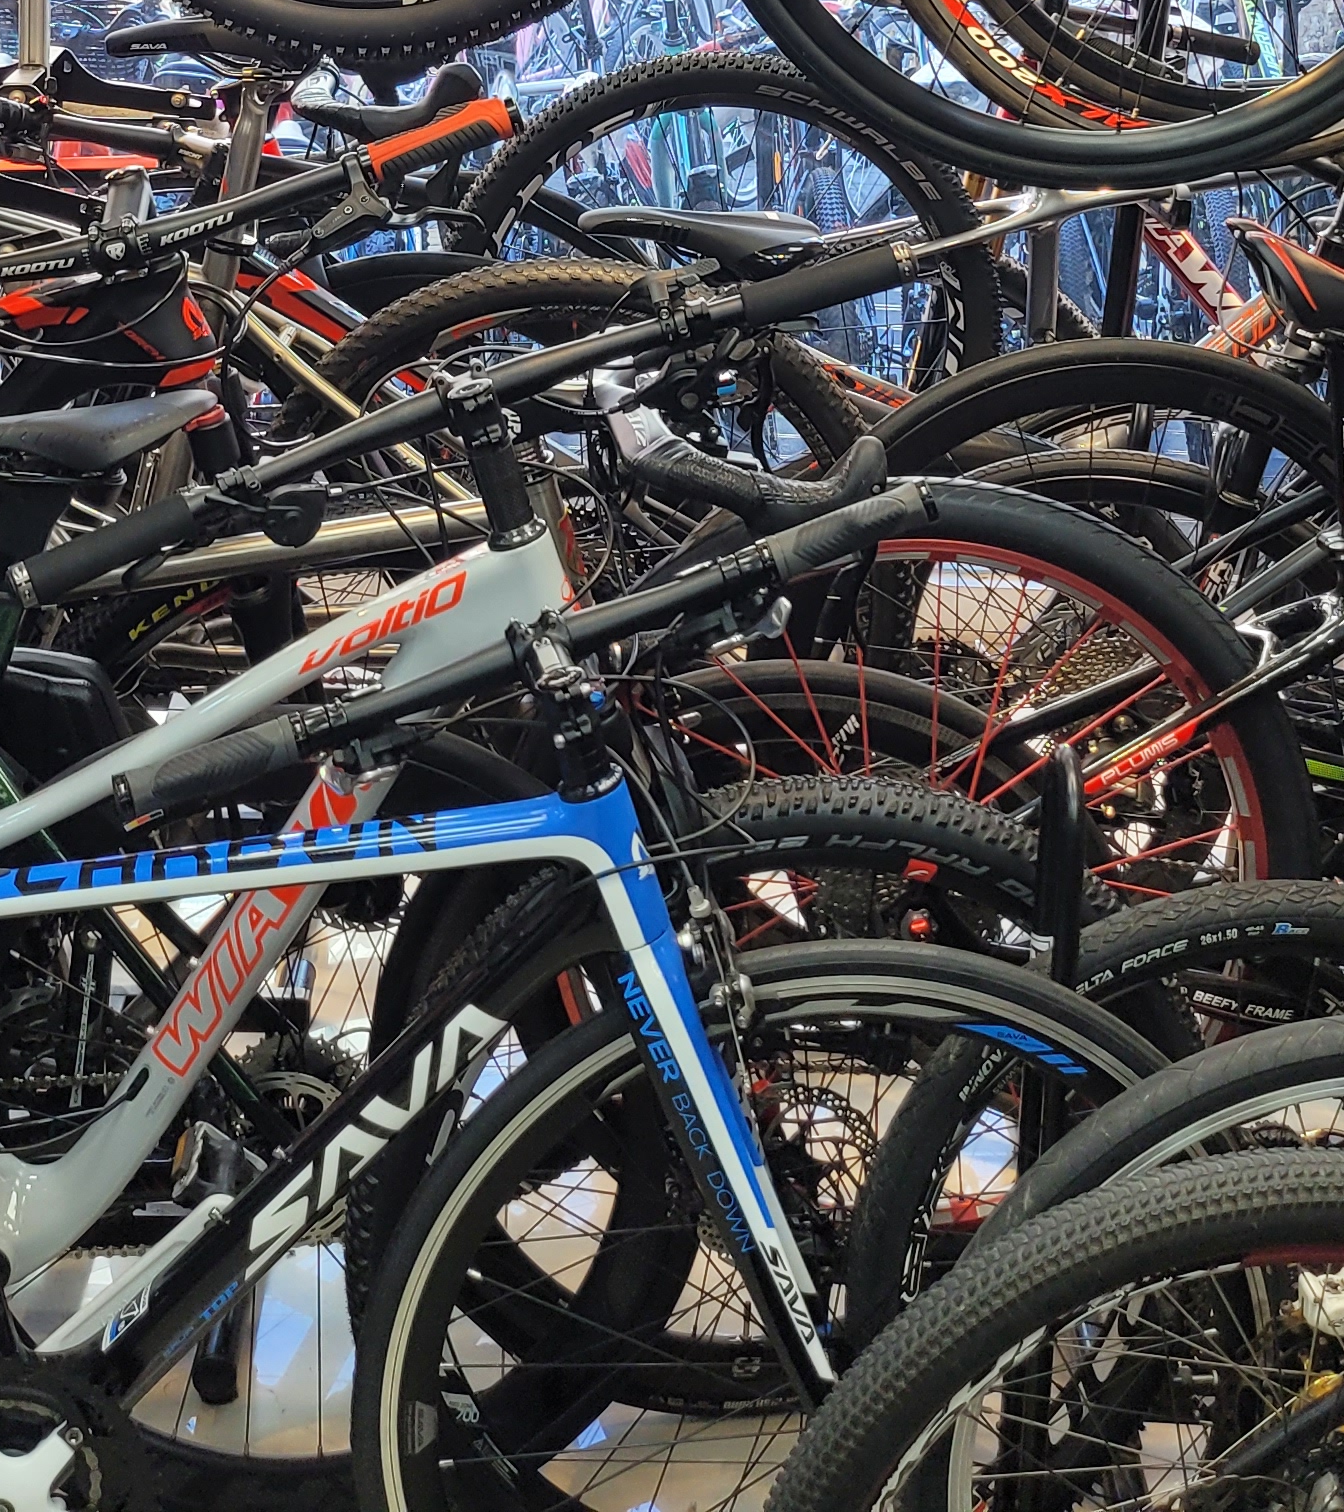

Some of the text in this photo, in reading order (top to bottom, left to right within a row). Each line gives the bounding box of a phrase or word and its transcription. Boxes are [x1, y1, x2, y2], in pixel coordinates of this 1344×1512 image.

[129, 42, 168, 52] SAVA
[755, 84, 944, 202] SCHWALBE
[158, 210, 235, 248] KOOTU
[0, 257, 76, 277] KOOTU
[1099, 732, 1179, 786] PLUMIS
[824, 833, 991, 877] RALPH
[1074, 969, 1115, 994] ELTA
[1120, 938, 1189, 974] FORCE
[1192, 989, 1296, 1021] BEEFY FRAME
[247, 1004, 509, 1256] SAVA
[617, 970, 754, 1255] NEVER BACK DOWN
[759, 1239, 814, 1347] SAVA
